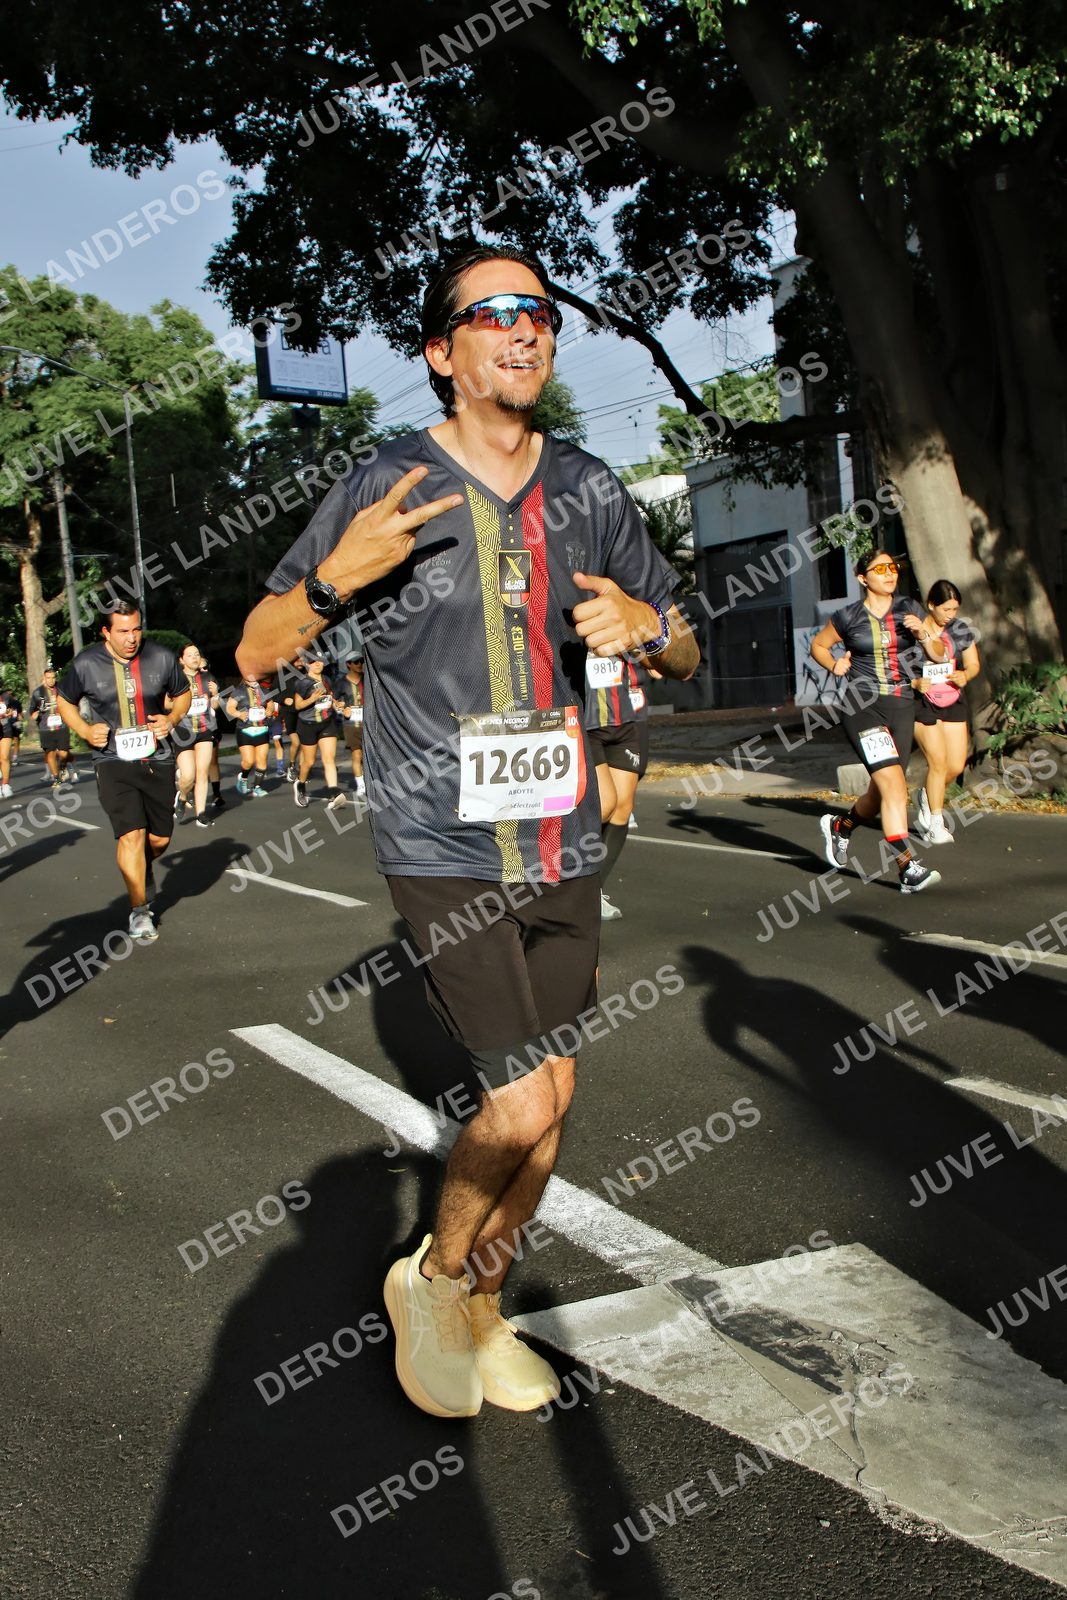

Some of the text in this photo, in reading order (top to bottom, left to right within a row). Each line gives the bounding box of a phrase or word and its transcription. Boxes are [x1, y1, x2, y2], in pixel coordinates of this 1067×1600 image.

[593, 660, 618, 674] 9816
[479, 718, 502, 726] LENES
[122, 735, 149, 750] 9727
[469, 744, 571, 786] 12669
